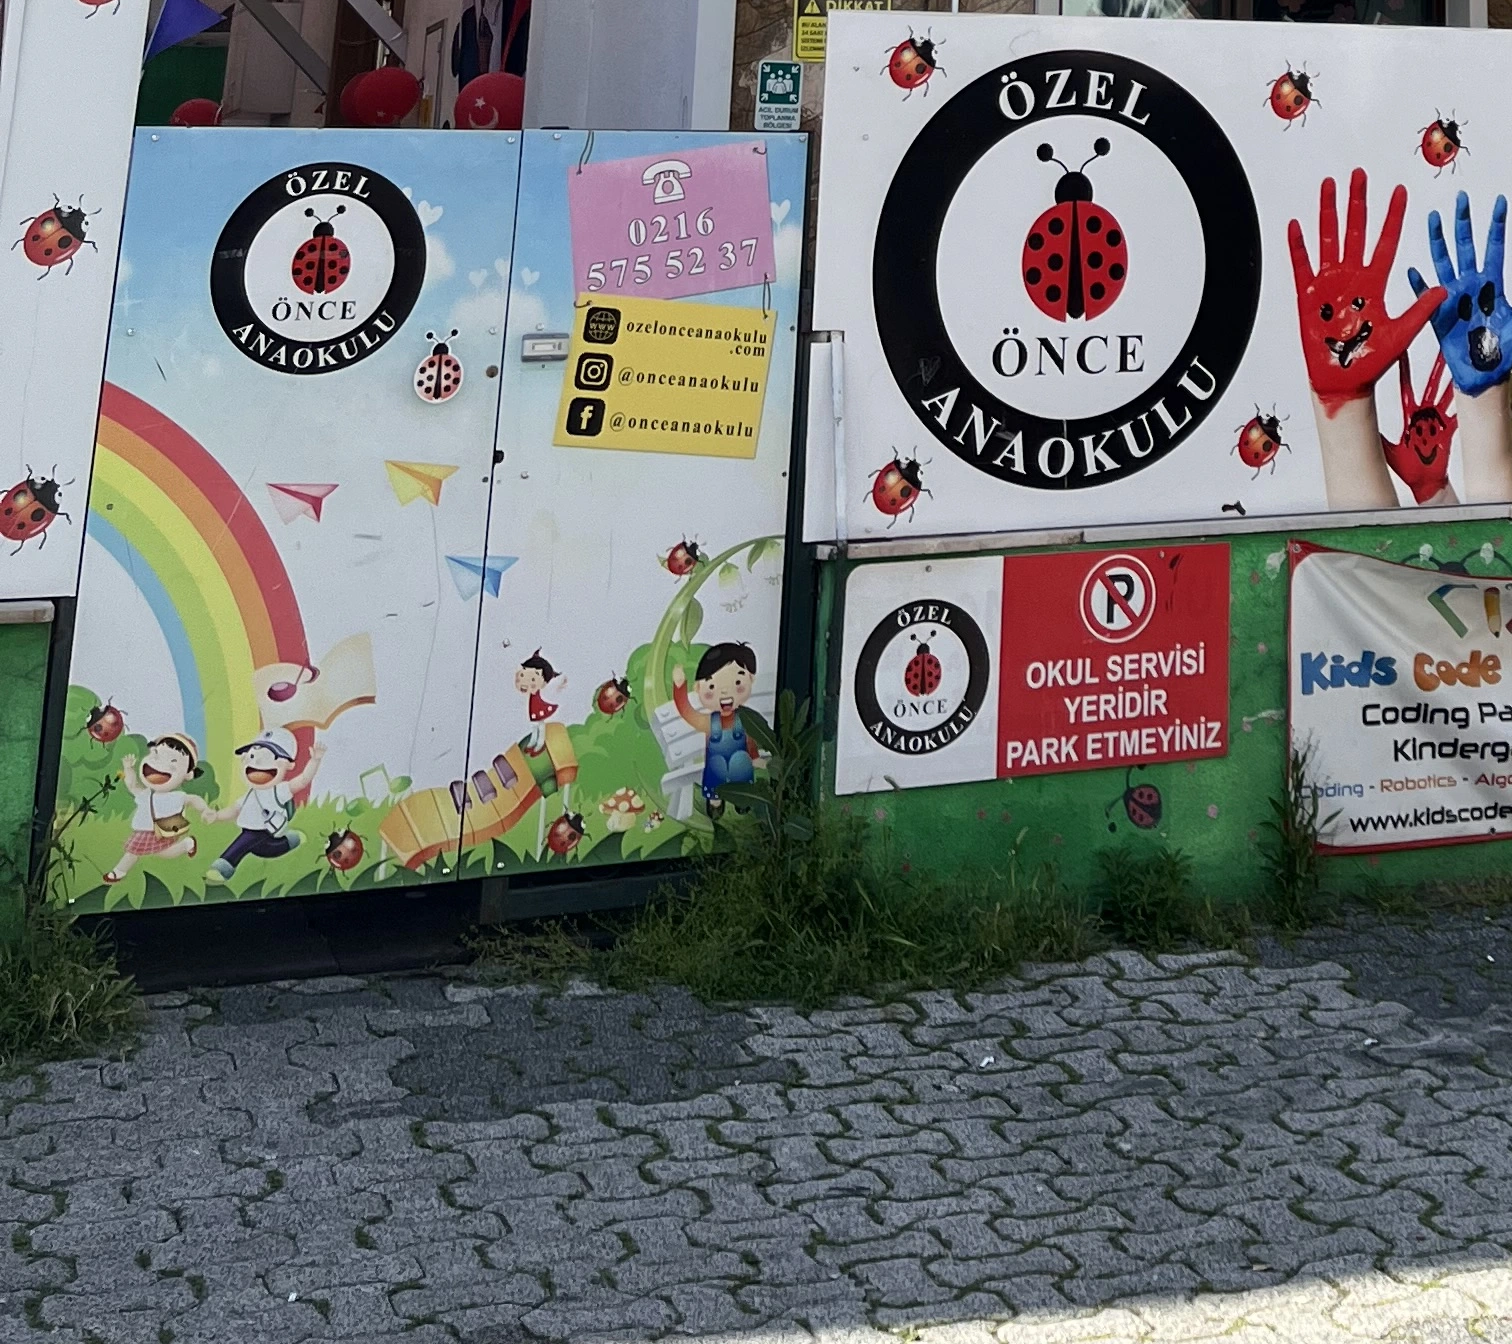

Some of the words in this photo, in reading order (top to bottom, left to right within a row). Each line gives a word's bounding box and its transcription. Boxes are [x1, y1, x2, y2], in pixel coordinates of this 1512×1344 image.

[999, 68, 1152, 125] ÖZEL
[285, 169, 372, 199] ÖZEL
[628, 207, 715, 247] 0216
[586, 254, 653, 292] 575
[665, 247, 706, 280] 52
[718, 237, 759, 271] 37
[271, 296, 357, 322] ÖNCE
[232, 309, 397, 369] ANAOKULU
[626, 320, 768, 345] ozelonceanaokulu
[729, 343, 766, 357] .com
[992, 326, 1146, 378] ÖNCE
[617, 366, 759, 393] @onceanaokulu
[609, 411, 754, 438] @onceanaokulu
[921, 356, 1218, 480] ANAOKULU
[896, 604, 953, 628] ÖZEL
[1026, 657, 1099, 690] OKUL
[1106, 641, 1205, 683] SERVİSİ
[1301, 650, 1398, 695] Kids
[1413, 650, 1502, 692] Code
[893, 698, 949, 719] ÖNCE
[1064, 684, 1168, 725] YERİDİR
[1362, 702, 1471, 729] Coding
[869, 702, 975, 753] ANAOKULU
[1006, 735, 1079, 769] PARK
[1086, 716, 1223, 761] ETMEYİNİZ
[1380, 773, 1458, 793] Robotics
